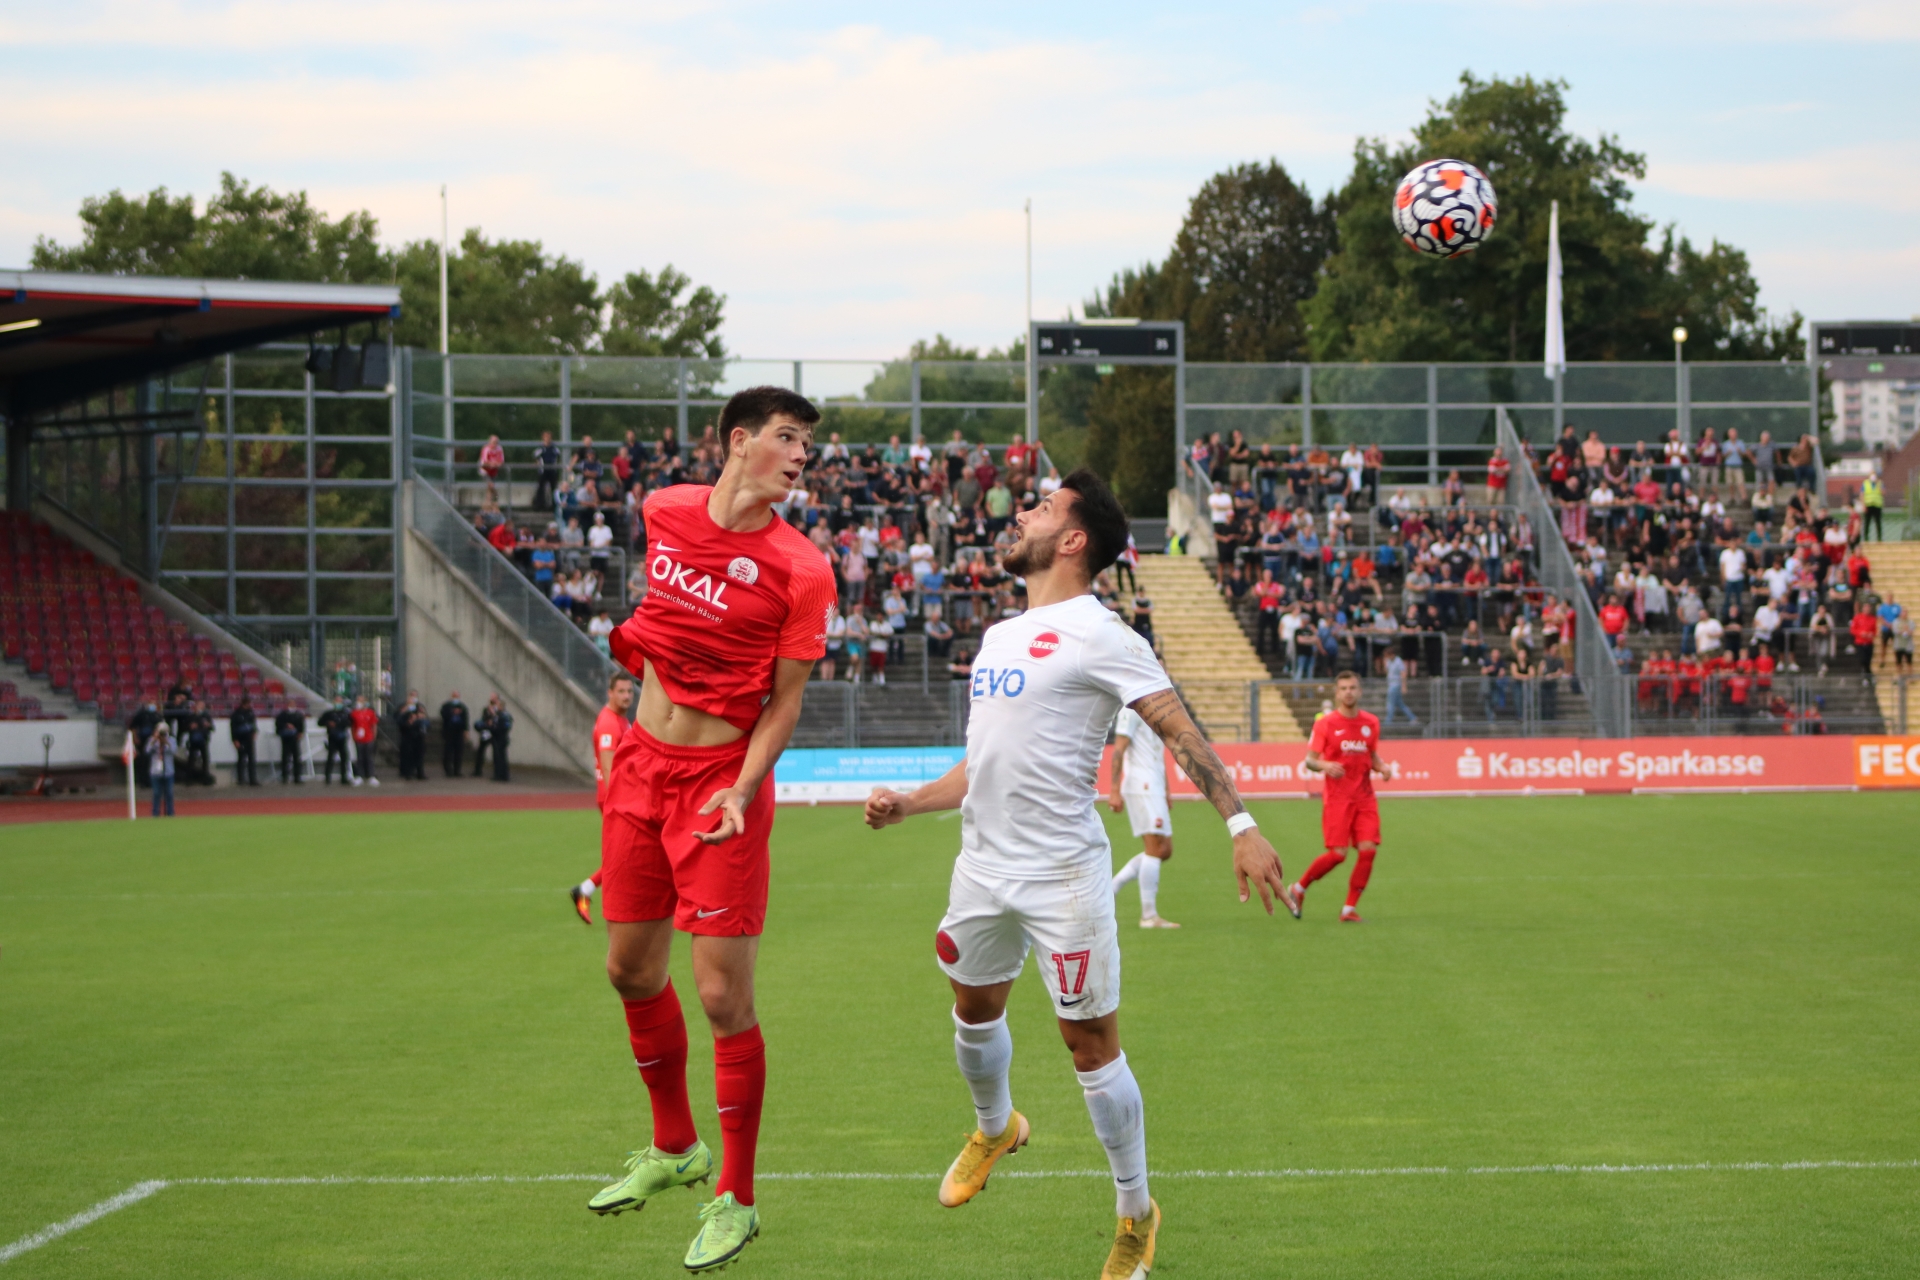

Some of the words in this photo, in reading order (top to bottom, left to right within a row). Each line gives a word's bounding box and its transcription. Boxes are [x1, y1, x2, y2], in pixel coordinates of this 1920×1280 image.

[651, 554, 729, 611] OKAL
[697, 605, 724, 624] Häuser
[1257, 764, 1292, 781] um
[1488, 749, 1612, 778] Kasseler
[1617, 749, 1765, 782] Sparkasse
[1051, 949, 1091, 995] 17
